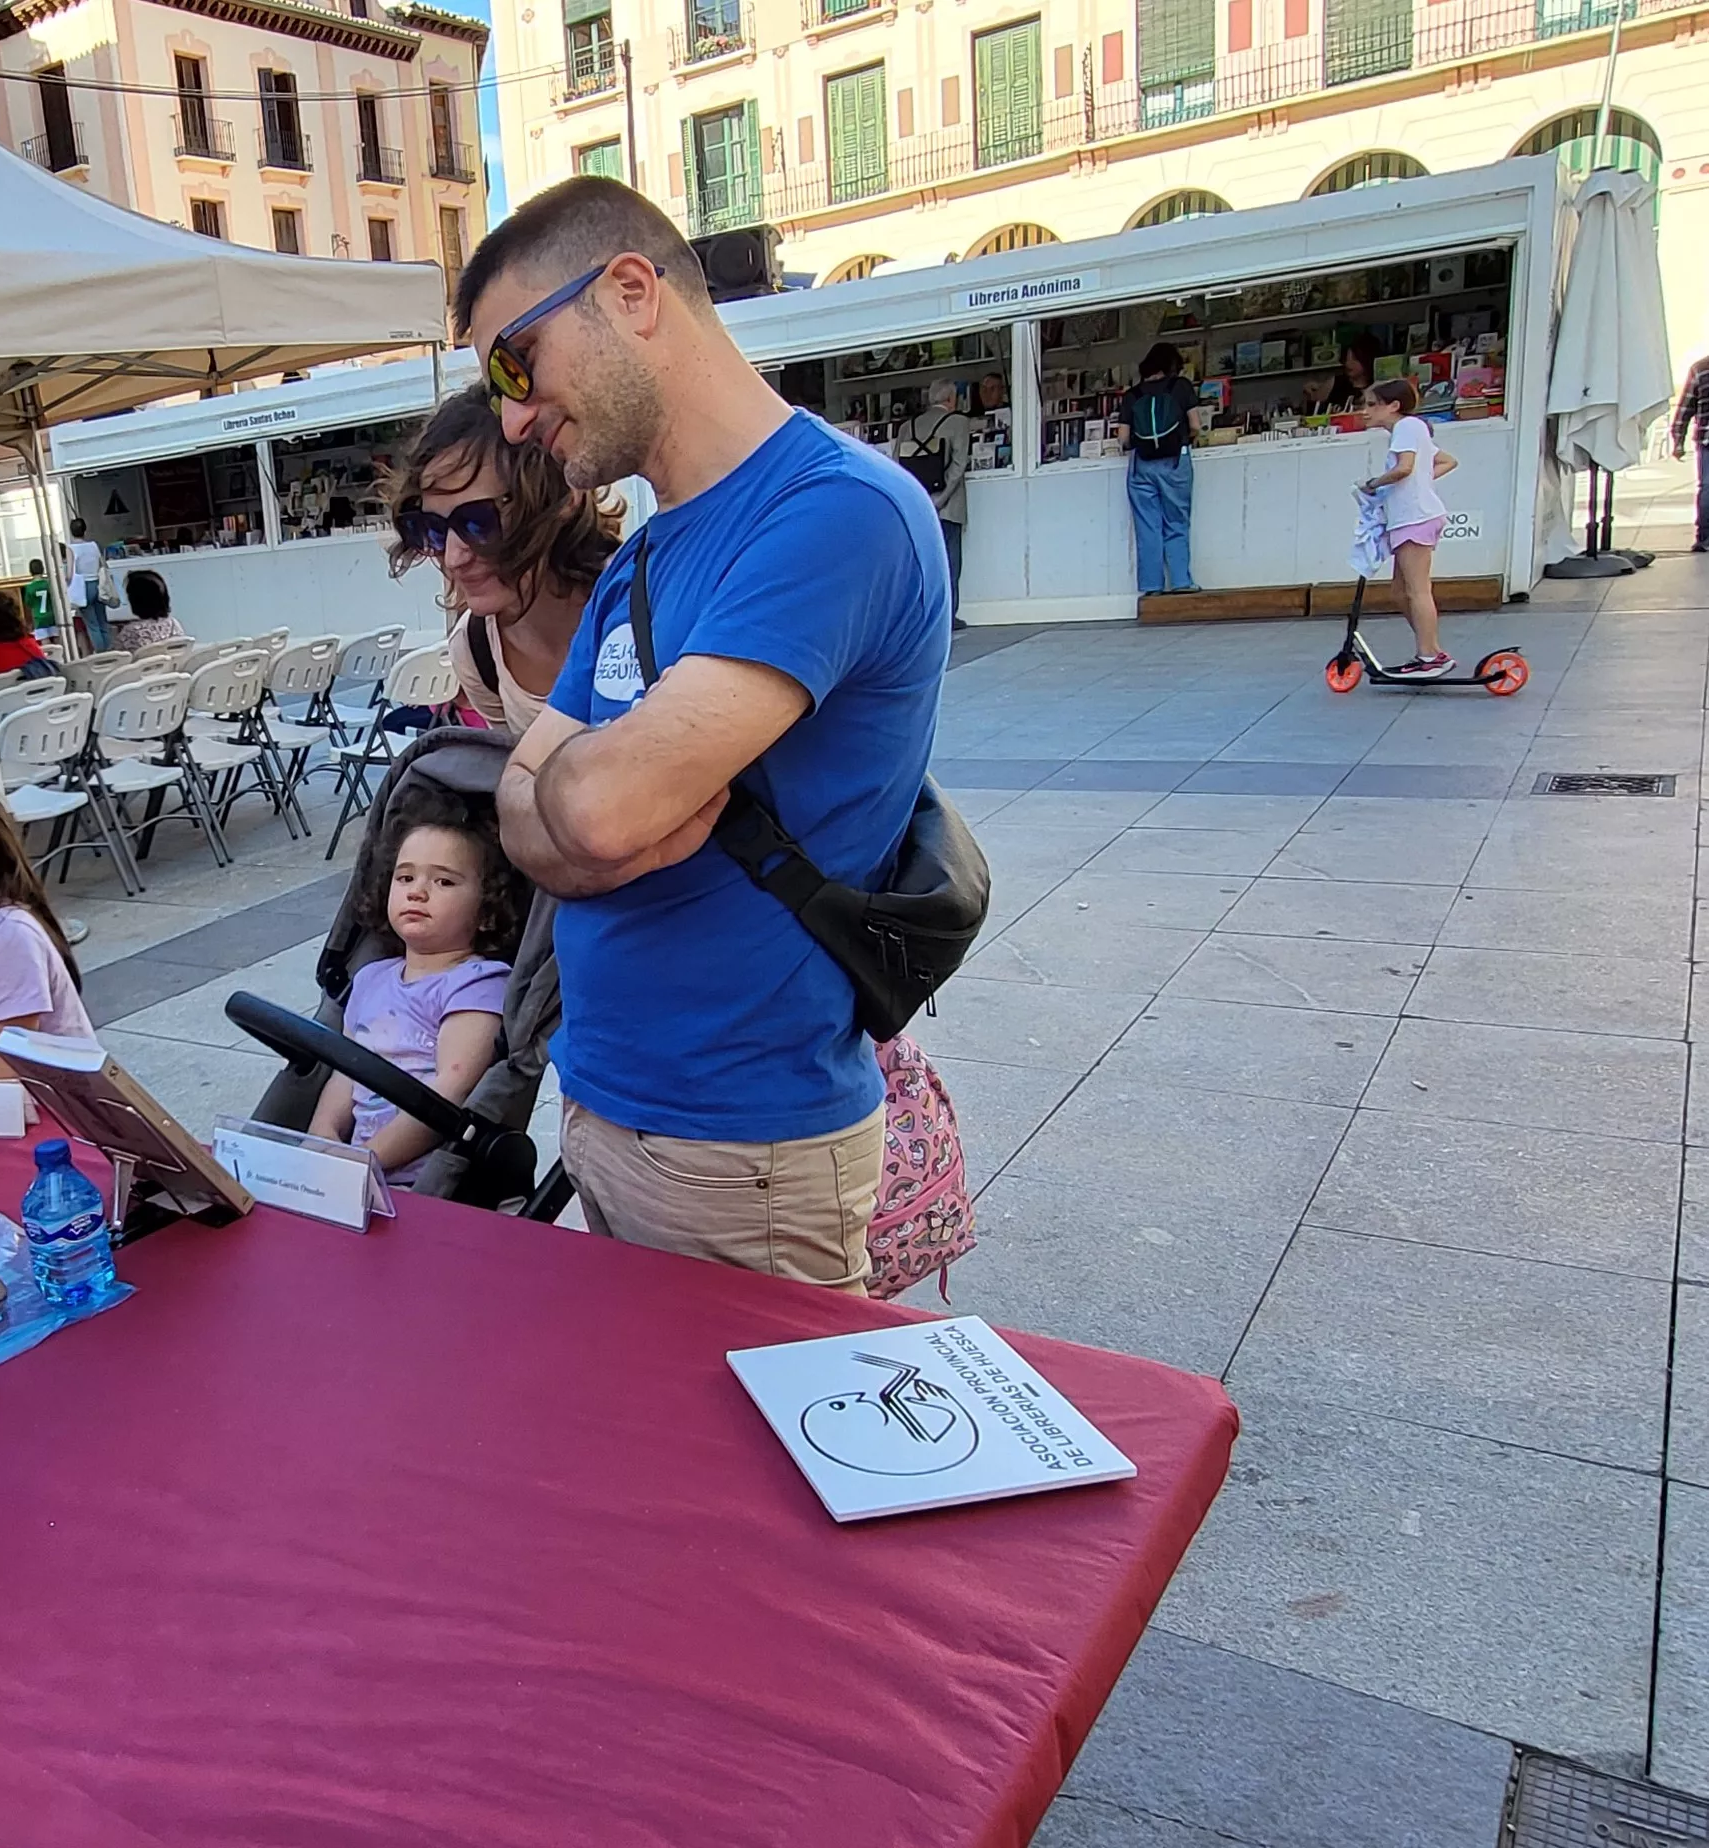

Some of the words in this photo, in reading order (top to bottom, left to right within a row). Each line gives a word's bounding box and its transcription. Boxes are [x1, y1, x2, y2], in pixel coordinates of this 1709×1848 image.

[968, 286, 1018, 307] Librería
[1021, 277, 1081, 299] Anónima
[273, 409, 296, 421] Ochoa
[1441, 525, 1480, 538] GON
[35, 589, 48, 613] 7
[943, 1324, 992, 1368] HUESCA
[924, 1332, 991, 1395] PROVINCIAL
[984, 1367, 1010, 1385] DE
[982, 1396, 1068, 1471] ASOCIACIÓN
[1064, 1448, 1094, 1468] DE
